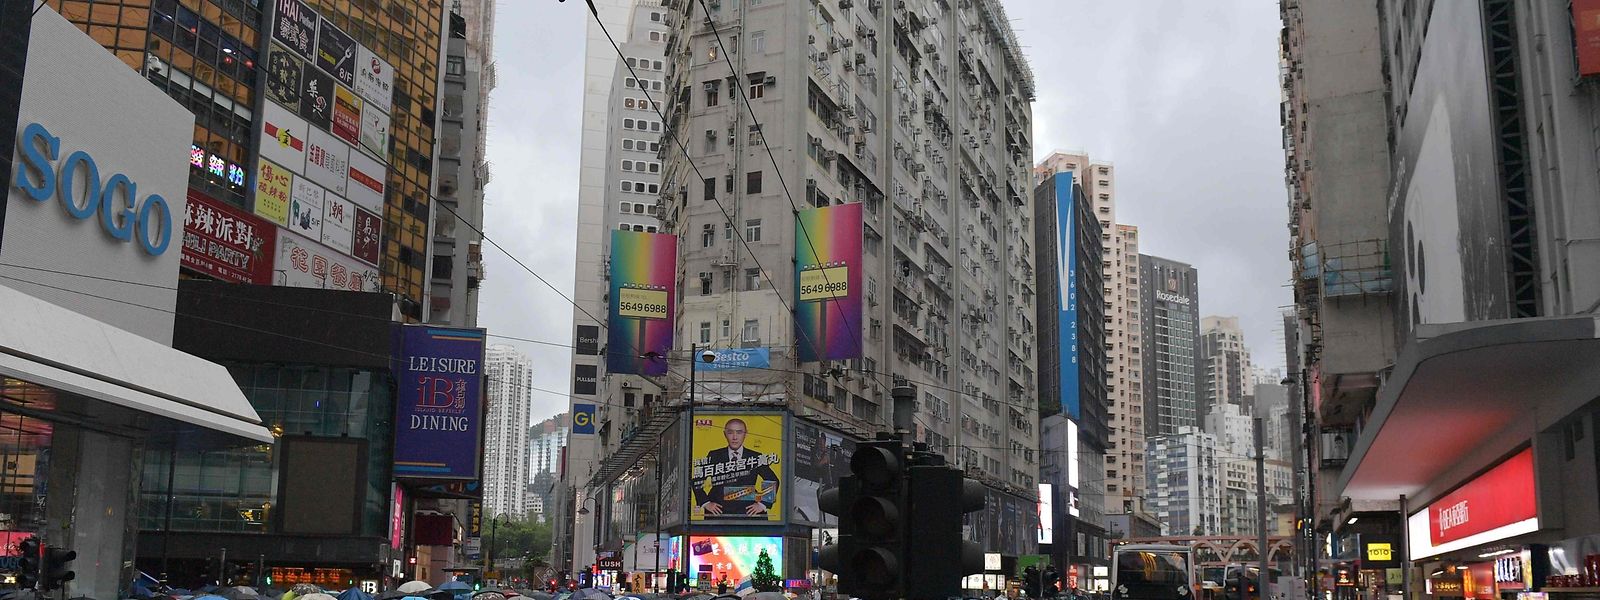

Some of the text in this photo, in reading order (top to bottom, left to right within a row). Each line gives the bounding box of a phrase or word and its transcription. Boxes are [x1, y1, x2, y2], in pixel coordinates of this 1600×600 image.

[339, 67, 353, 82] 8/F
[261, 163, 289, 188] 傷心
[16, 123, 172, 256] SOGO
[311, 217, 320, 226] 5/F
[801, 281, 847, 295] 5649 6988
[1156, 289, 1190, 306] Rosedale
[620, 301, 667, 313] 5649 6988
[409, 356, 476, 374] LEISURE
[714, 352, 749, 362] Bestco
[410, 414, 469, 432] DINING
[693, 453, 779, 479] 馬百良安宮牛黃丸
